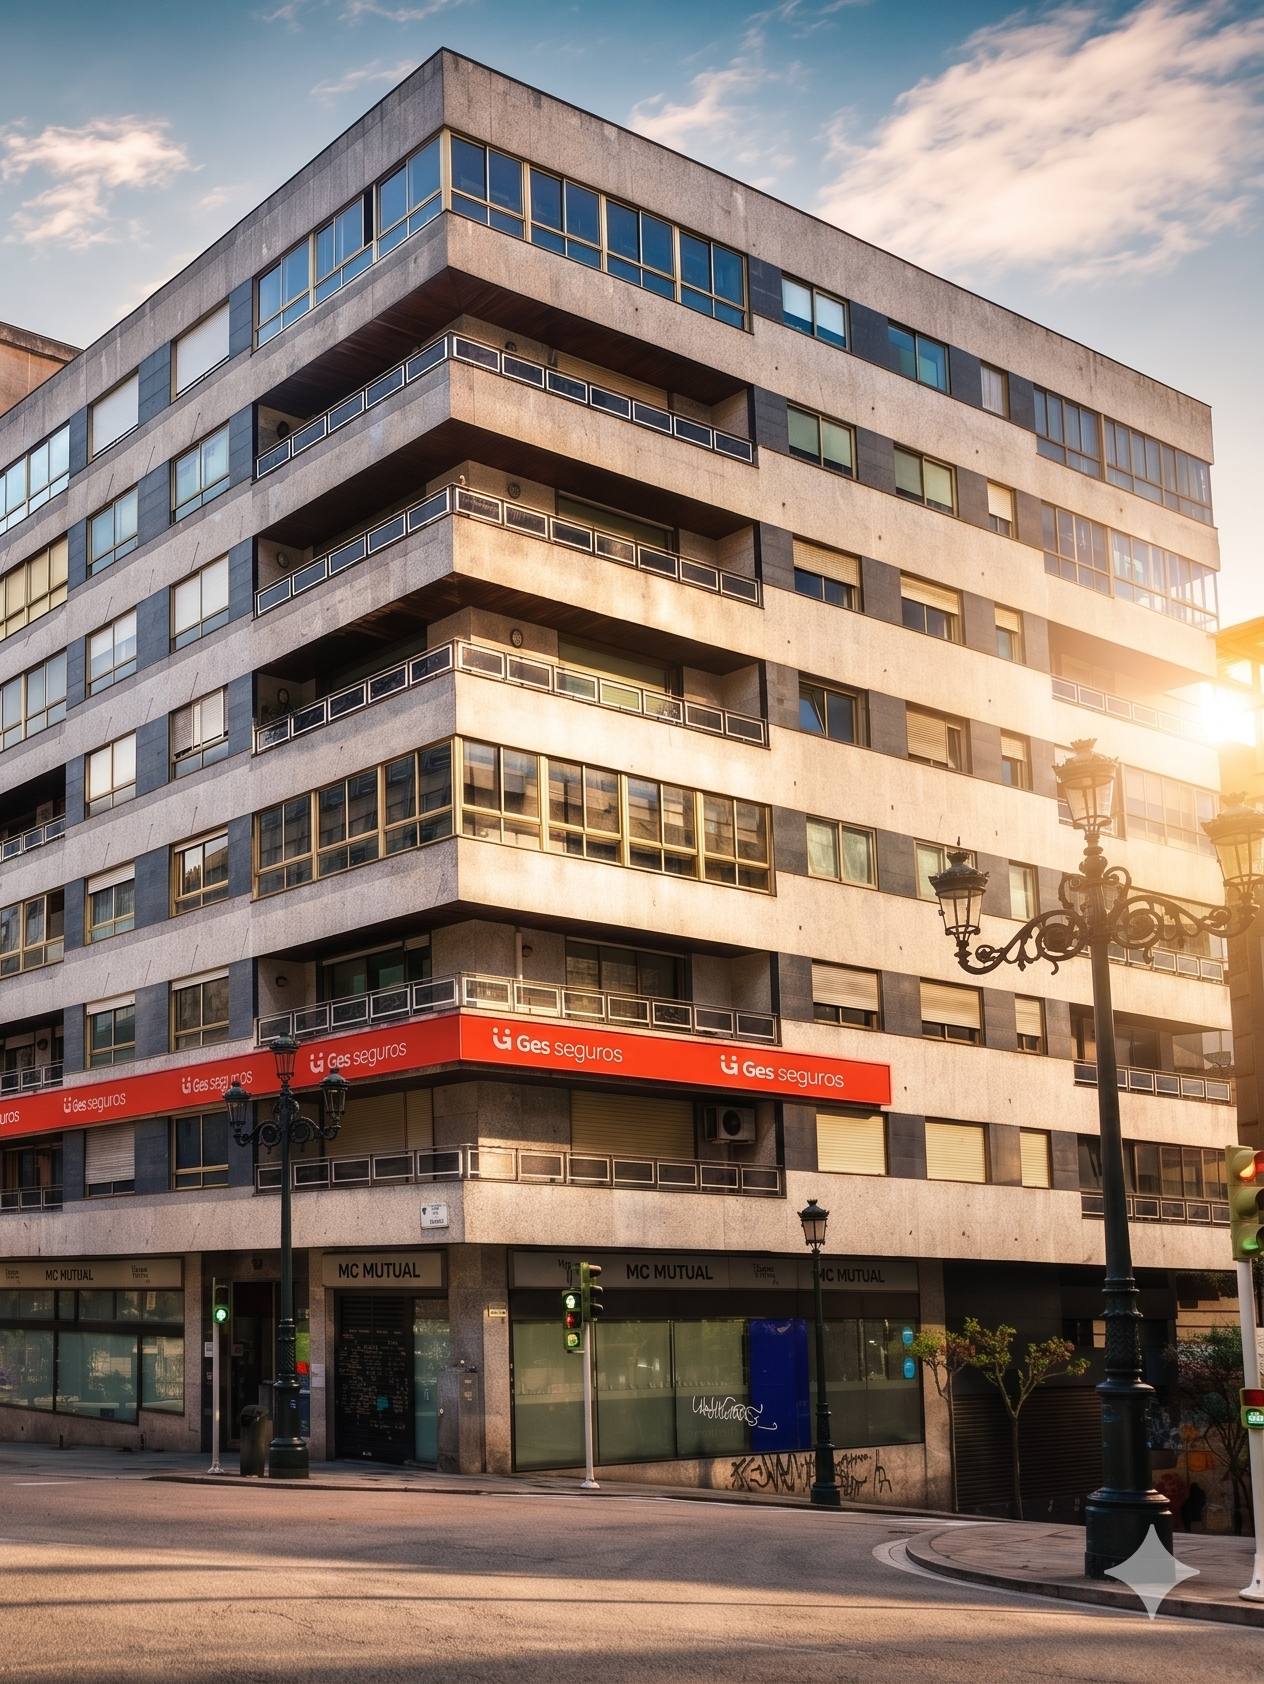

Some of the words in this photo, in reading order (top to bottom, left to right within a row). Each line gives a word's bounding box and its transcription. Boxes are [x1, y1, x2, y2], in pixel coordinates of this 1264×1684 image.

[327, 1052, 351, 1069] Ges
[353, 1042, 407, 1067] seguros
[516, 1034, 551, 1055] Ges
[554, 1042, 623, 1063] seguros
[742, 1061, 775, 1080] Ges
[777, 1068, 845, 1088] seguros
[192, 1078, 209, 1093] Ges
[72, 1099, 87, 1113] Ges
[87, 1092, 126, 1113] seguros
[45, 1269, 59, 1281] MC
[60, 1268, 94, 1281] MUTUAL
[338, 1263, 359, 1279] MC
[363, 1262, 421, 1279] MUTUAL
[626, 1264, 650, 1280] MC
[654, 1264, 713, 1281] MUTUAL
[837, 1268, 885, 1283] MUTUAL
